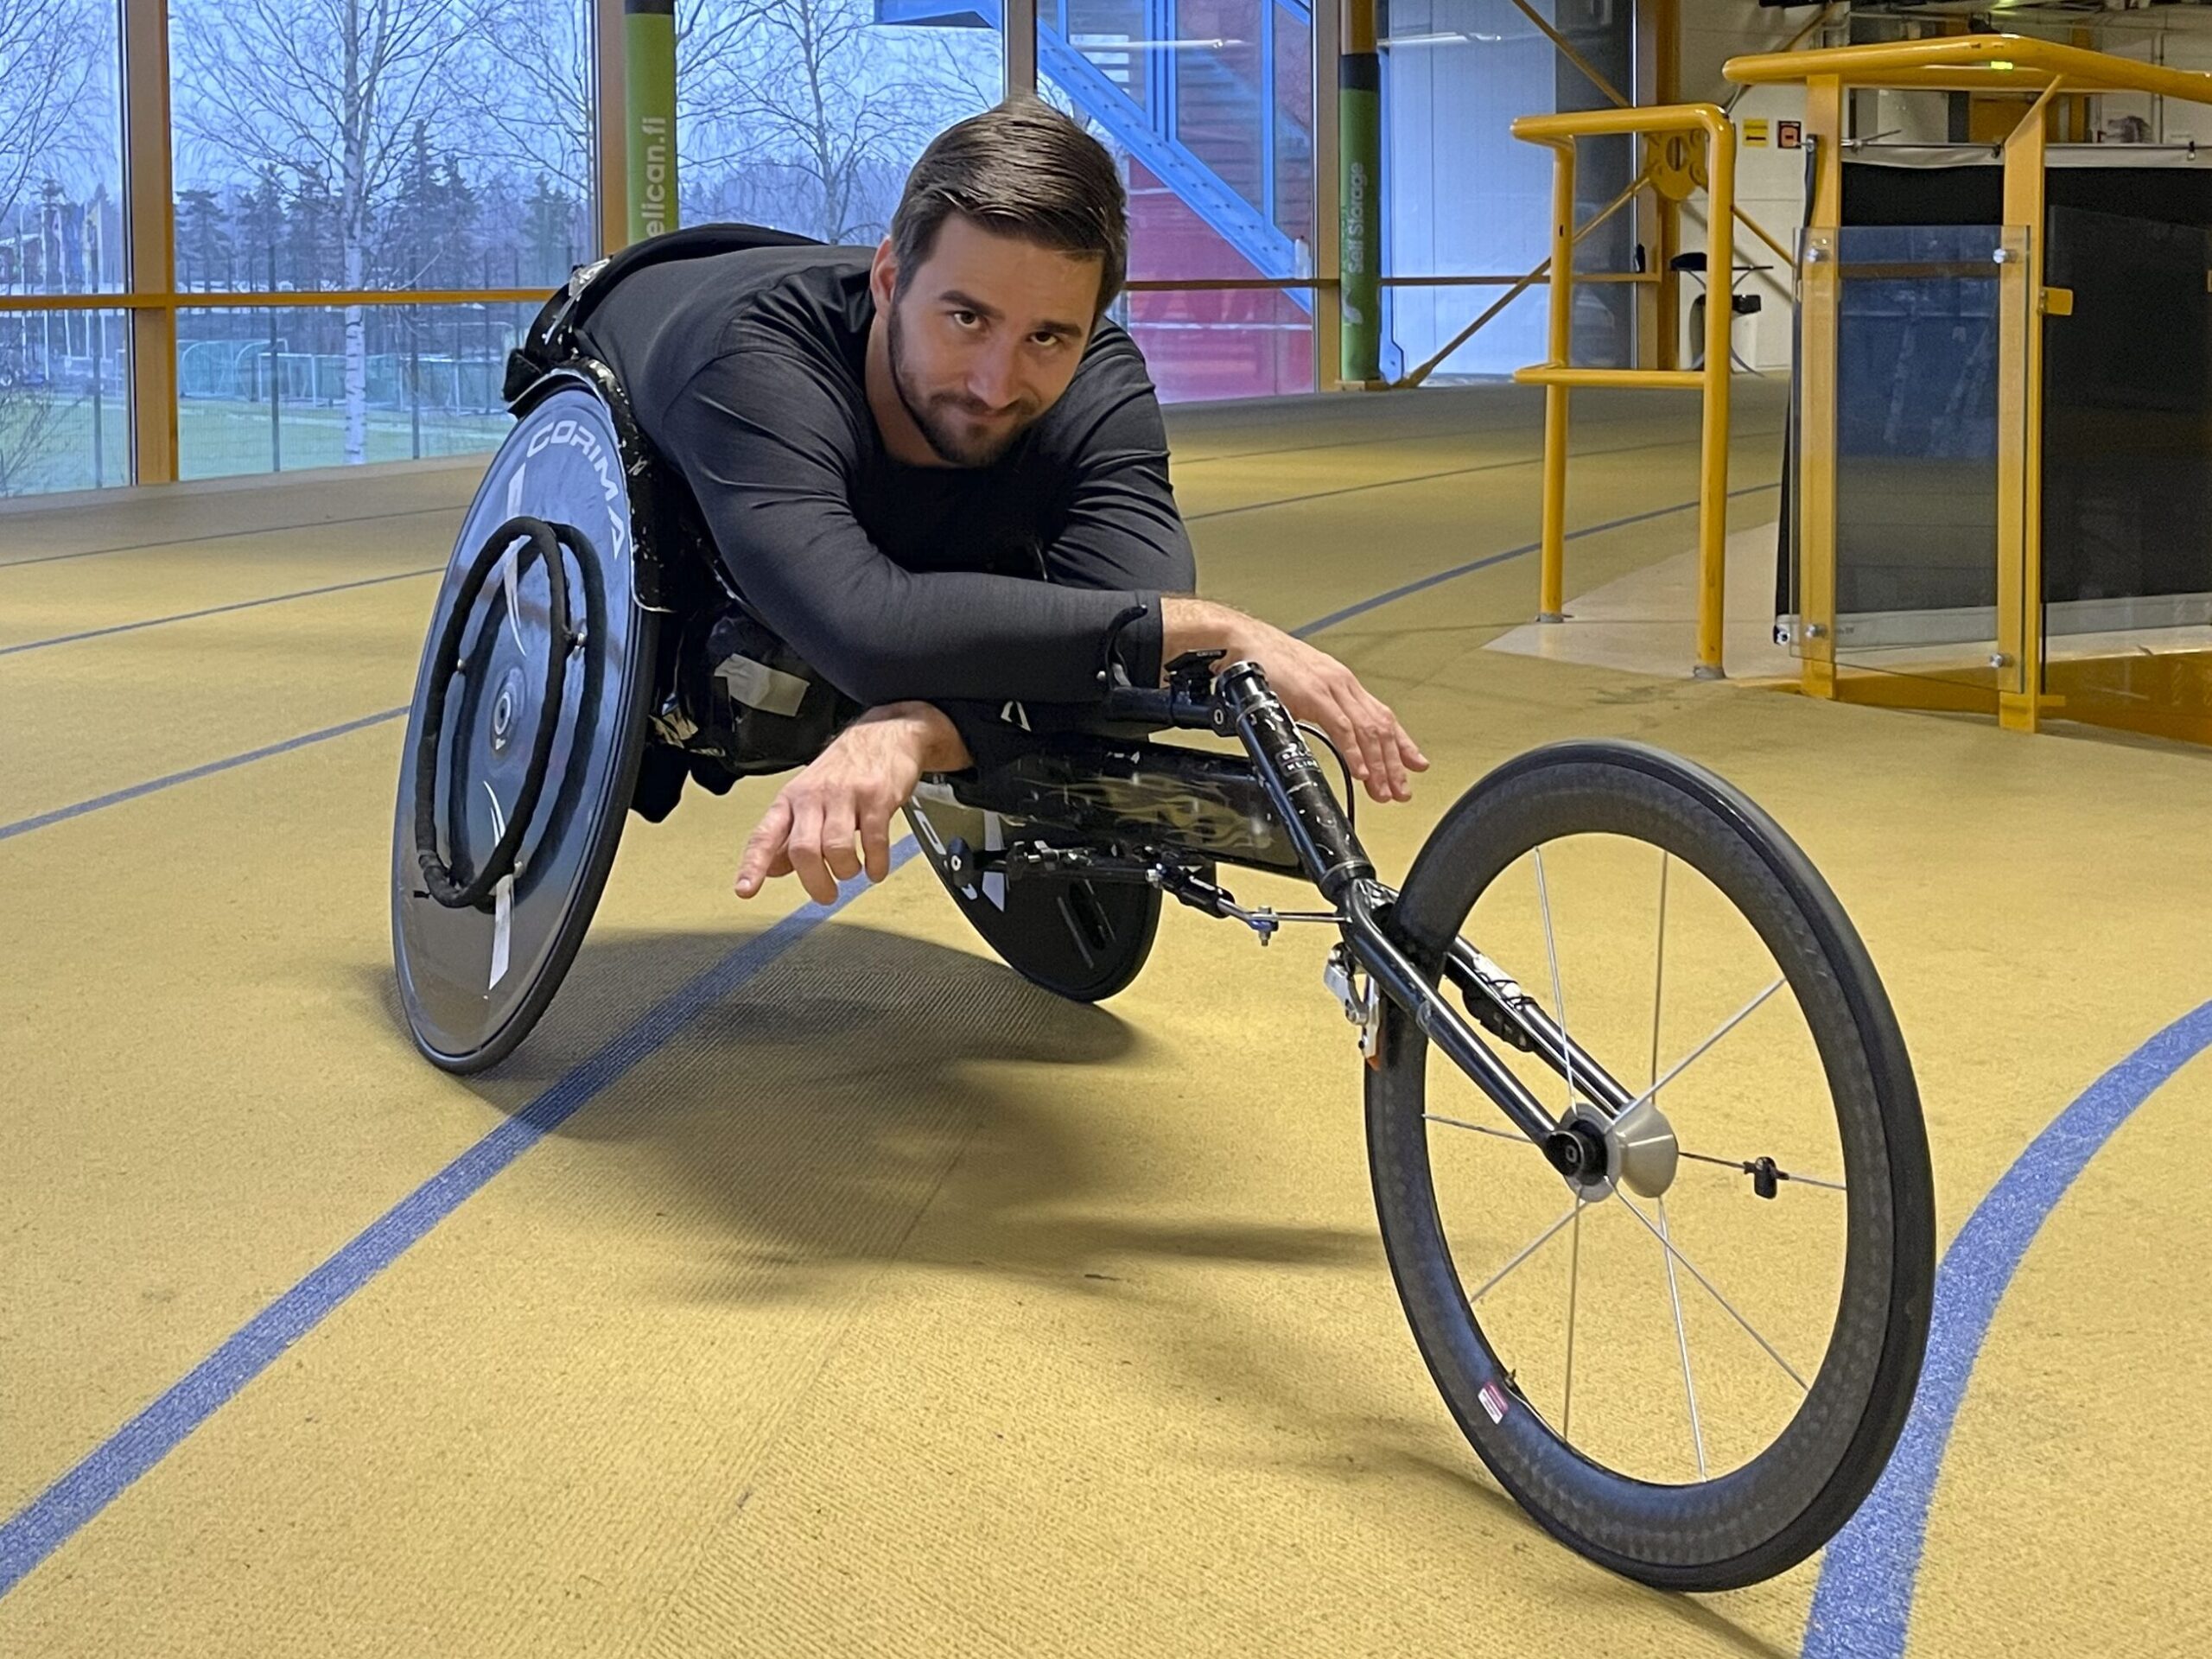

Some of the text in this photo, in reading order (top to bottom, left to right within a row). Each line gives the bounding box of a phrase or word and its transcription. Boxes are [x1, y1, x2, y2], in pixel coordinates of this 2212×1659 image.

[1348, 162, 1368, 273] Self Storage
[526, 420, 625, 561] CORIMA
